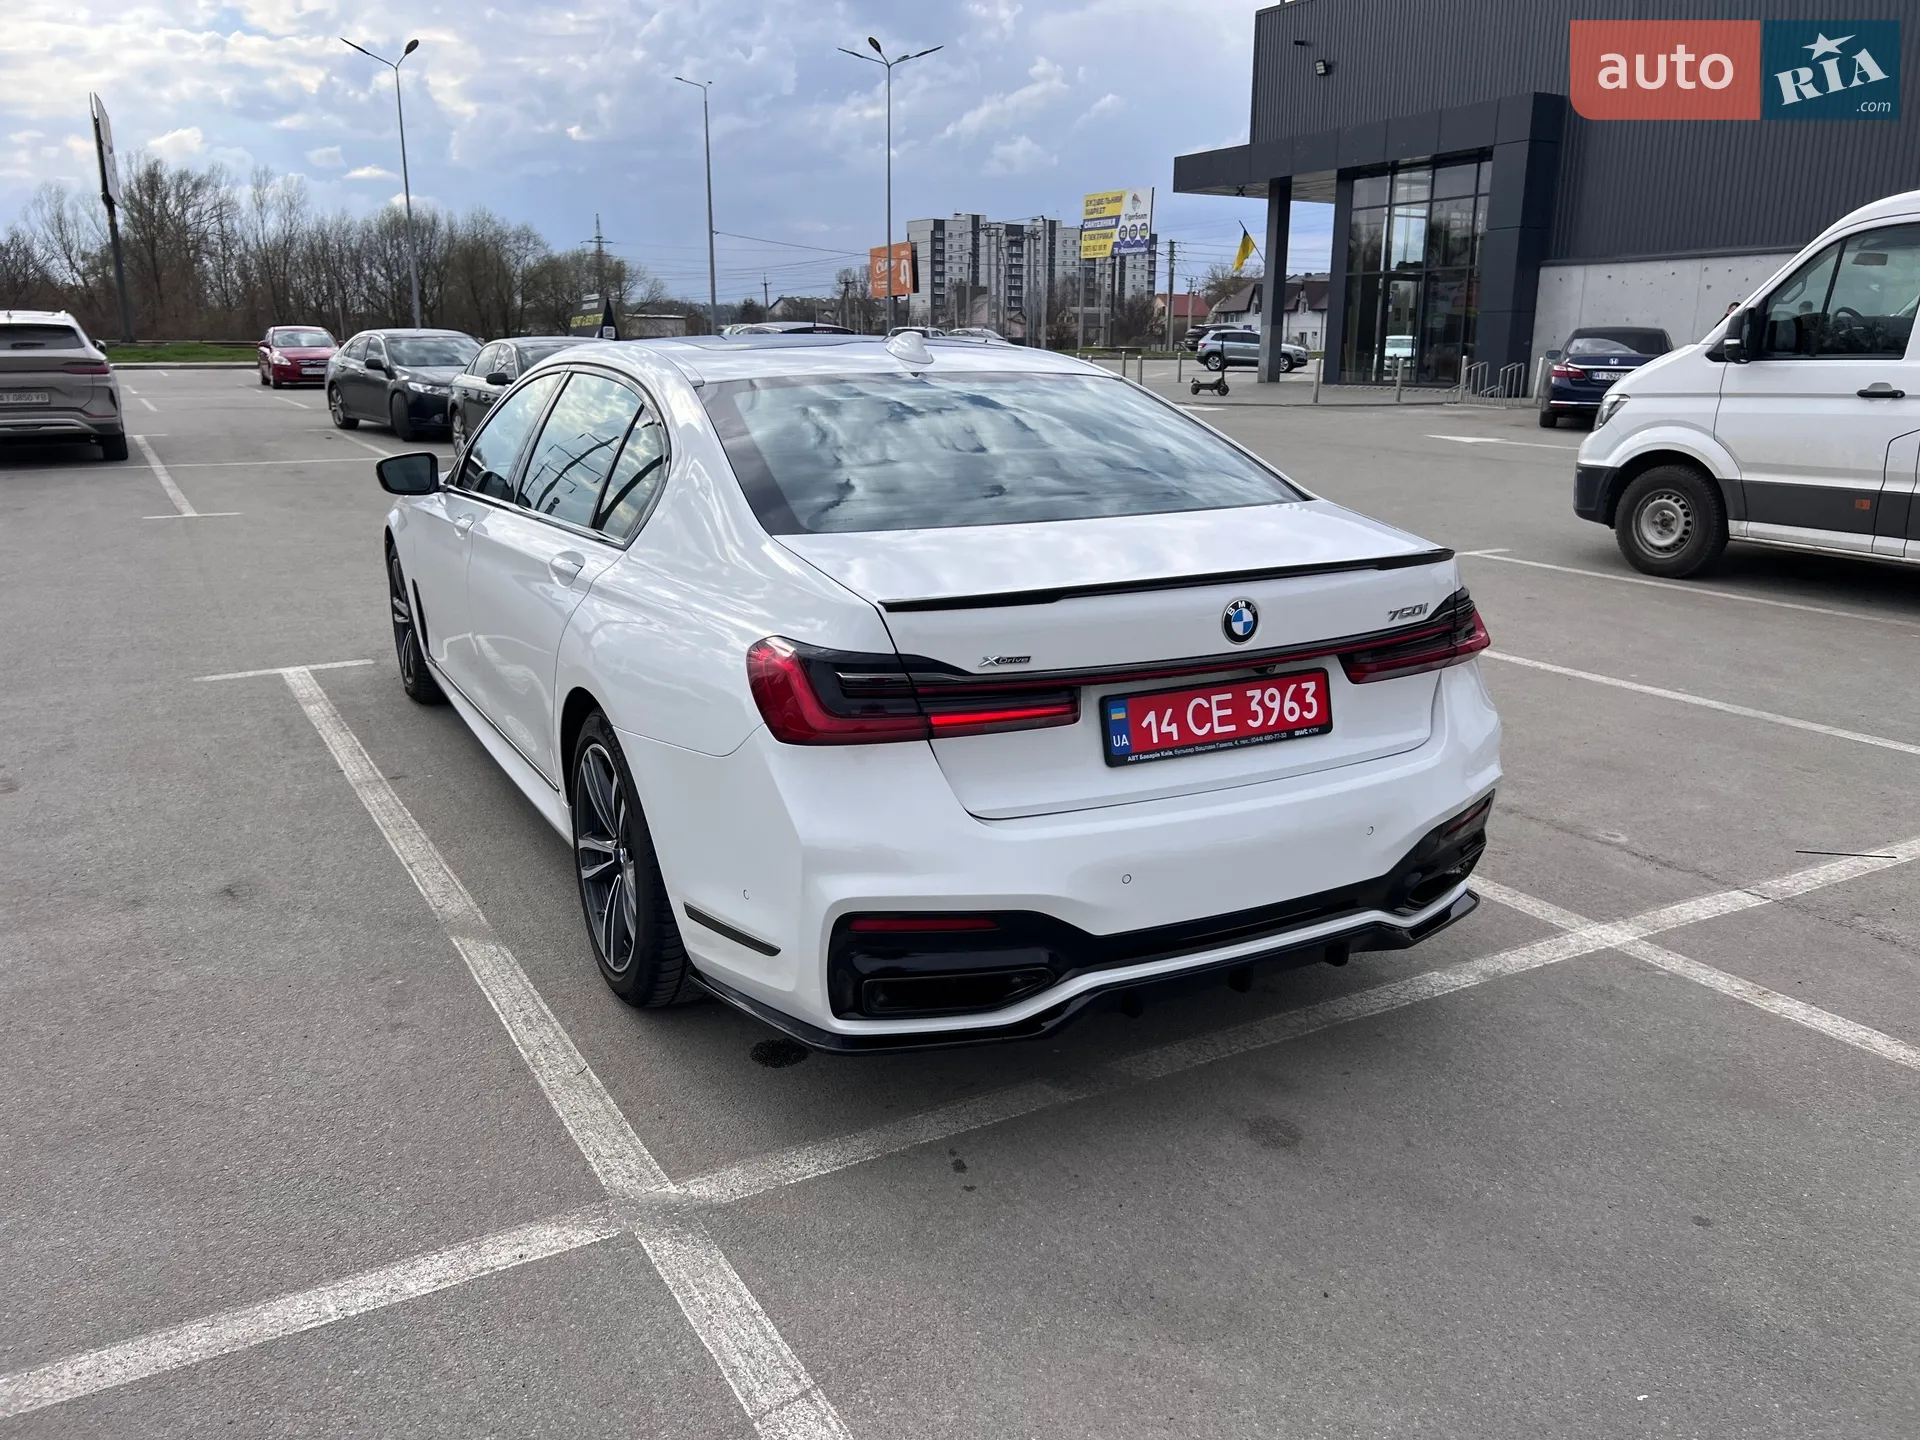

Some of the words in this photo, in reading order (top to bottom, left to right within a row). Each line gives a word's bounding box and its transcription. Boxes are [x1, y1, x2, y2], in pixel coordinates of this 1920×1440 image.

[1141, 708, 1178, 744] 14
[1186, 693, 1237, 736] CE
[1246, 681, 1318, 728] 3963
[1112, 734, 1129, 747] UA
